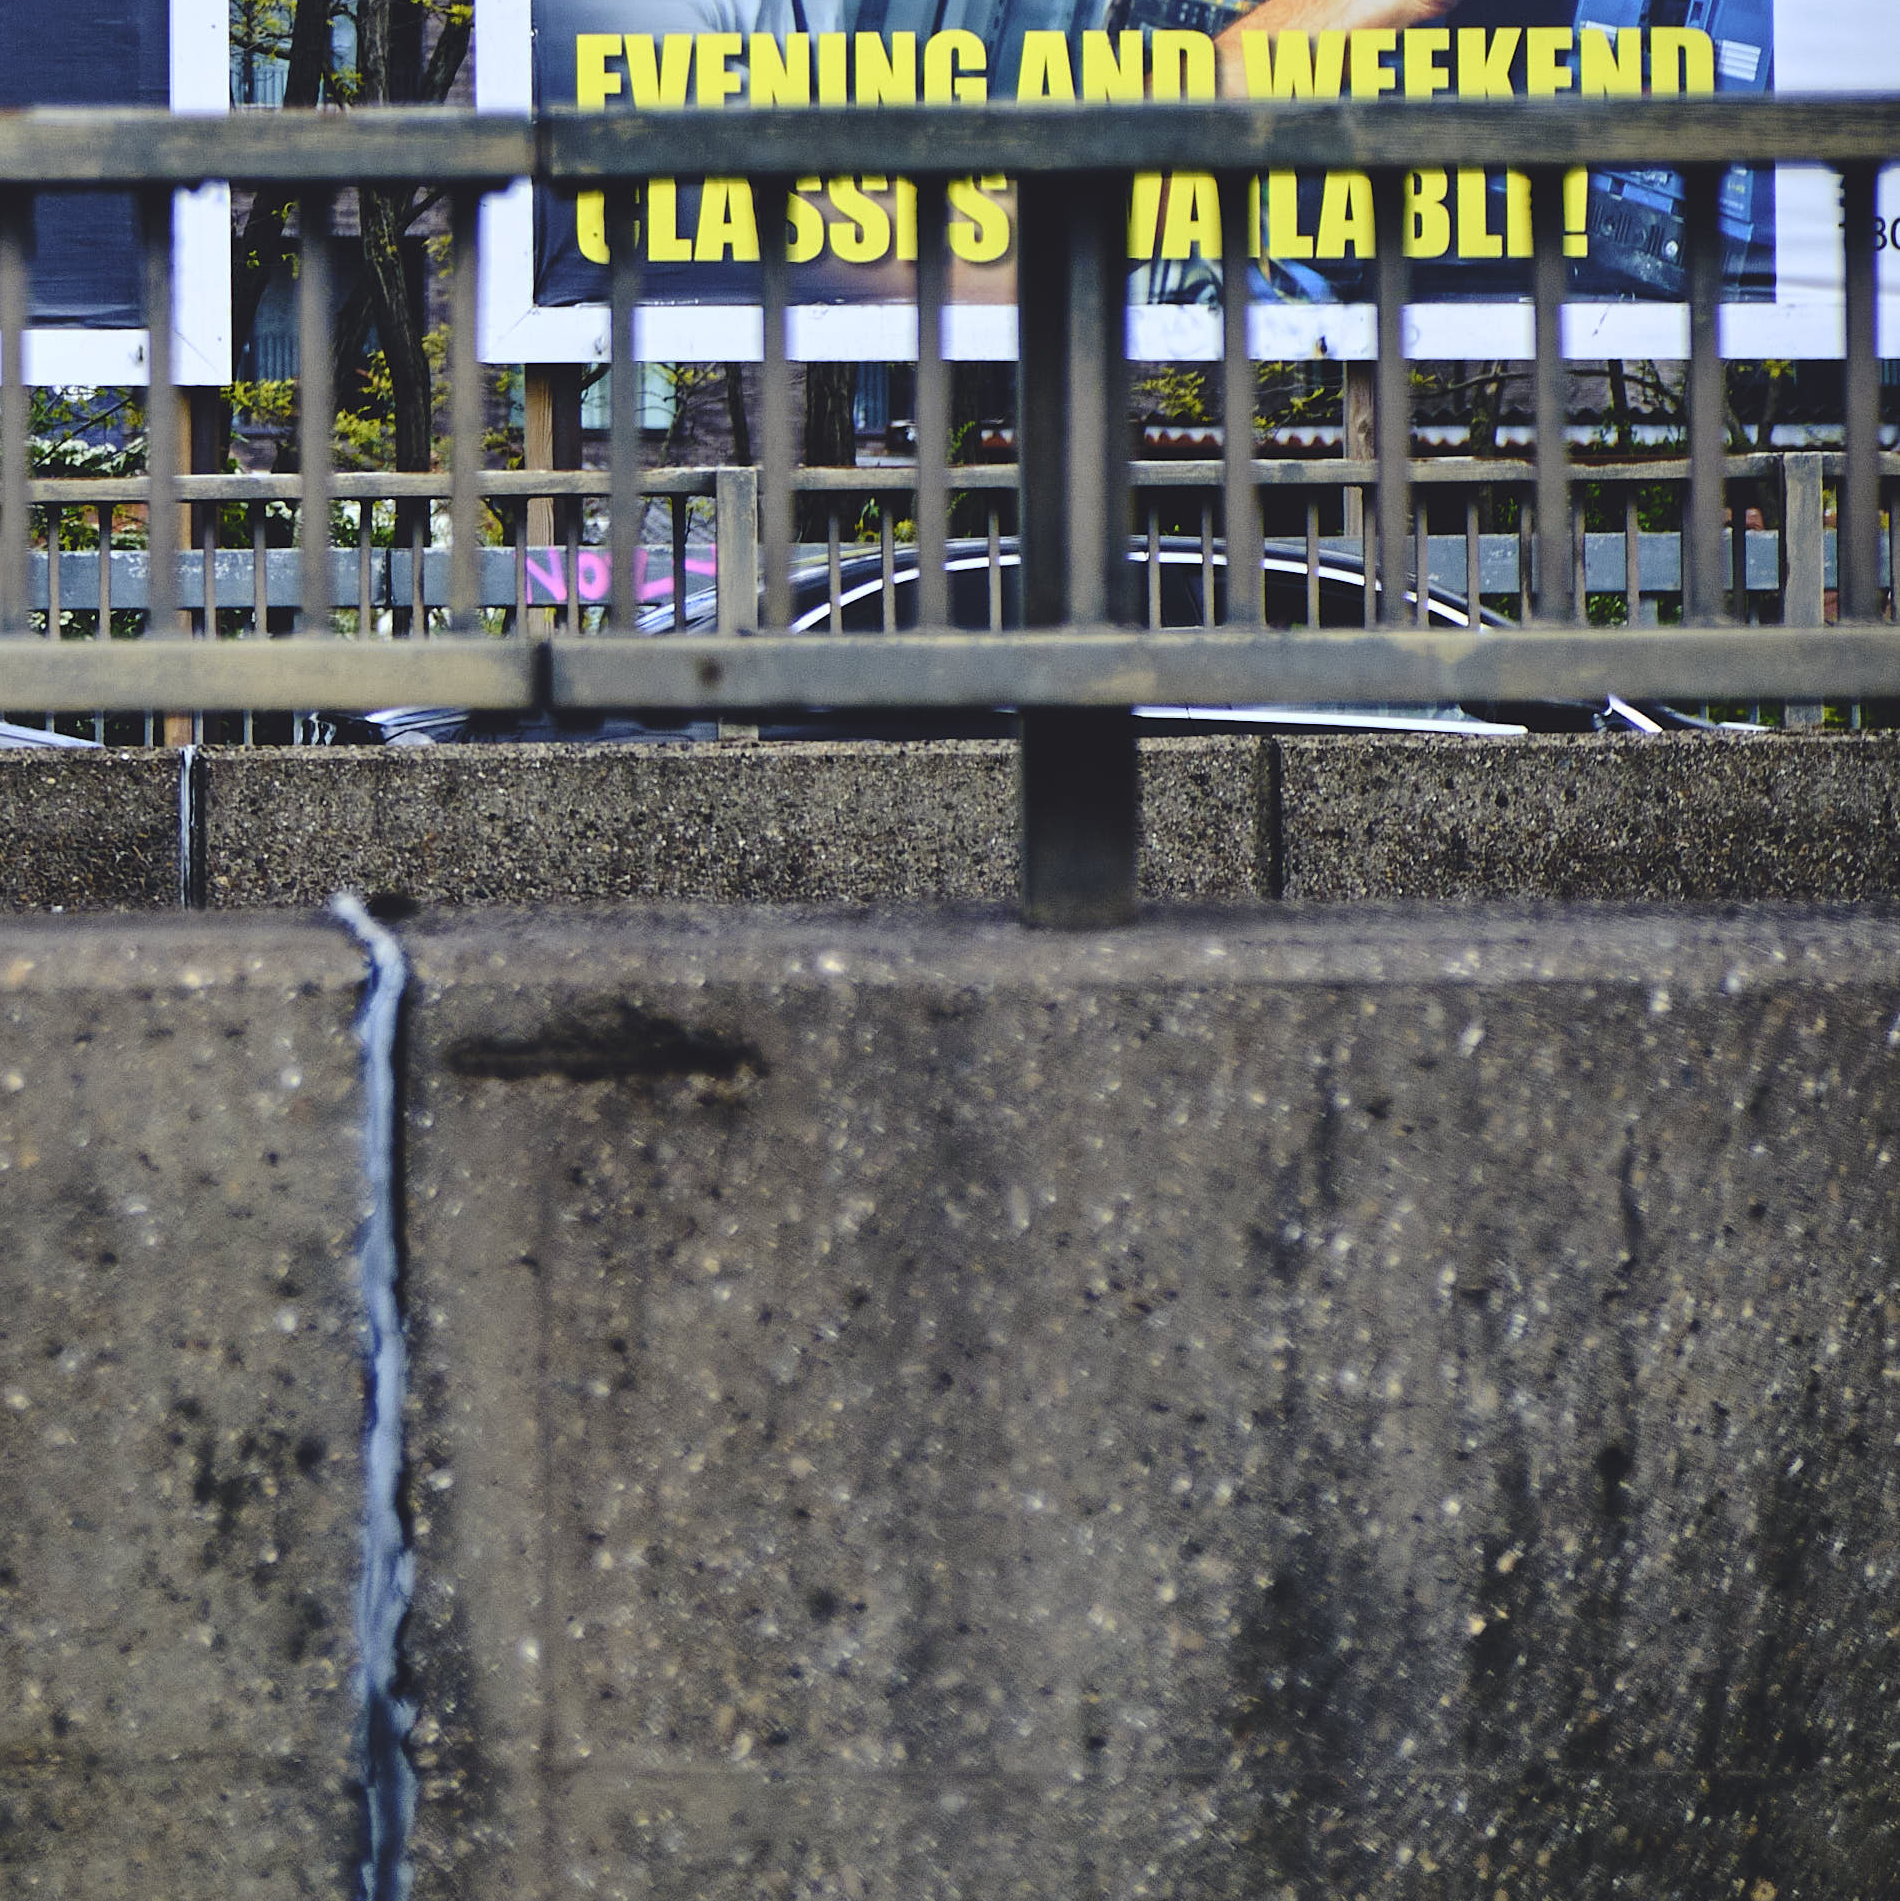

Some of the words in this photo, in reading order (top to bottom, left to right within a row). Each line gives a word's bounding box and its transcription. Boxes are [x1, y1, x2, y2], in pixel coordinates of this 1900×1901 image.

[576, 29, 989, 107] EVENING
[1017, 29, 1216, 104] AND
[1241, 27, 1715, 101] WEEKEND
